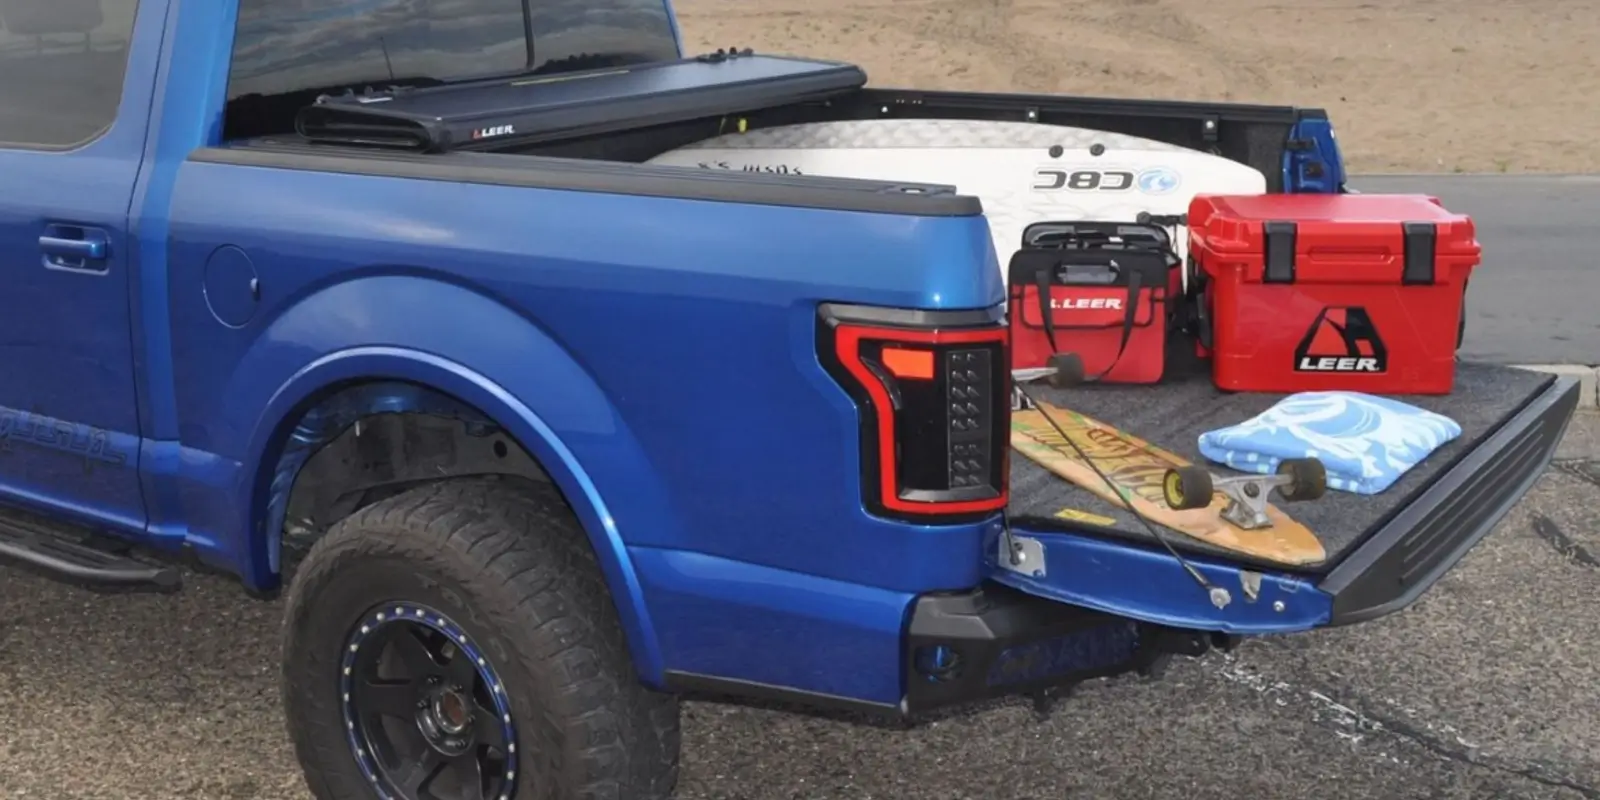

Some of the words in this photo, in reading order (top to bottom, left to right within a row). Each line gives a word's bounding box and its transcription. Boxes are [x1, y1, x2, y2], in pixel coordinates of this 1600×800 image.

[482, 125, 515, 137] LEER
[1033, 171, 1134, 190] CBC
[1062, 298, 1122, 310] LEER
[1300, 357, 1378, 371] LEER
